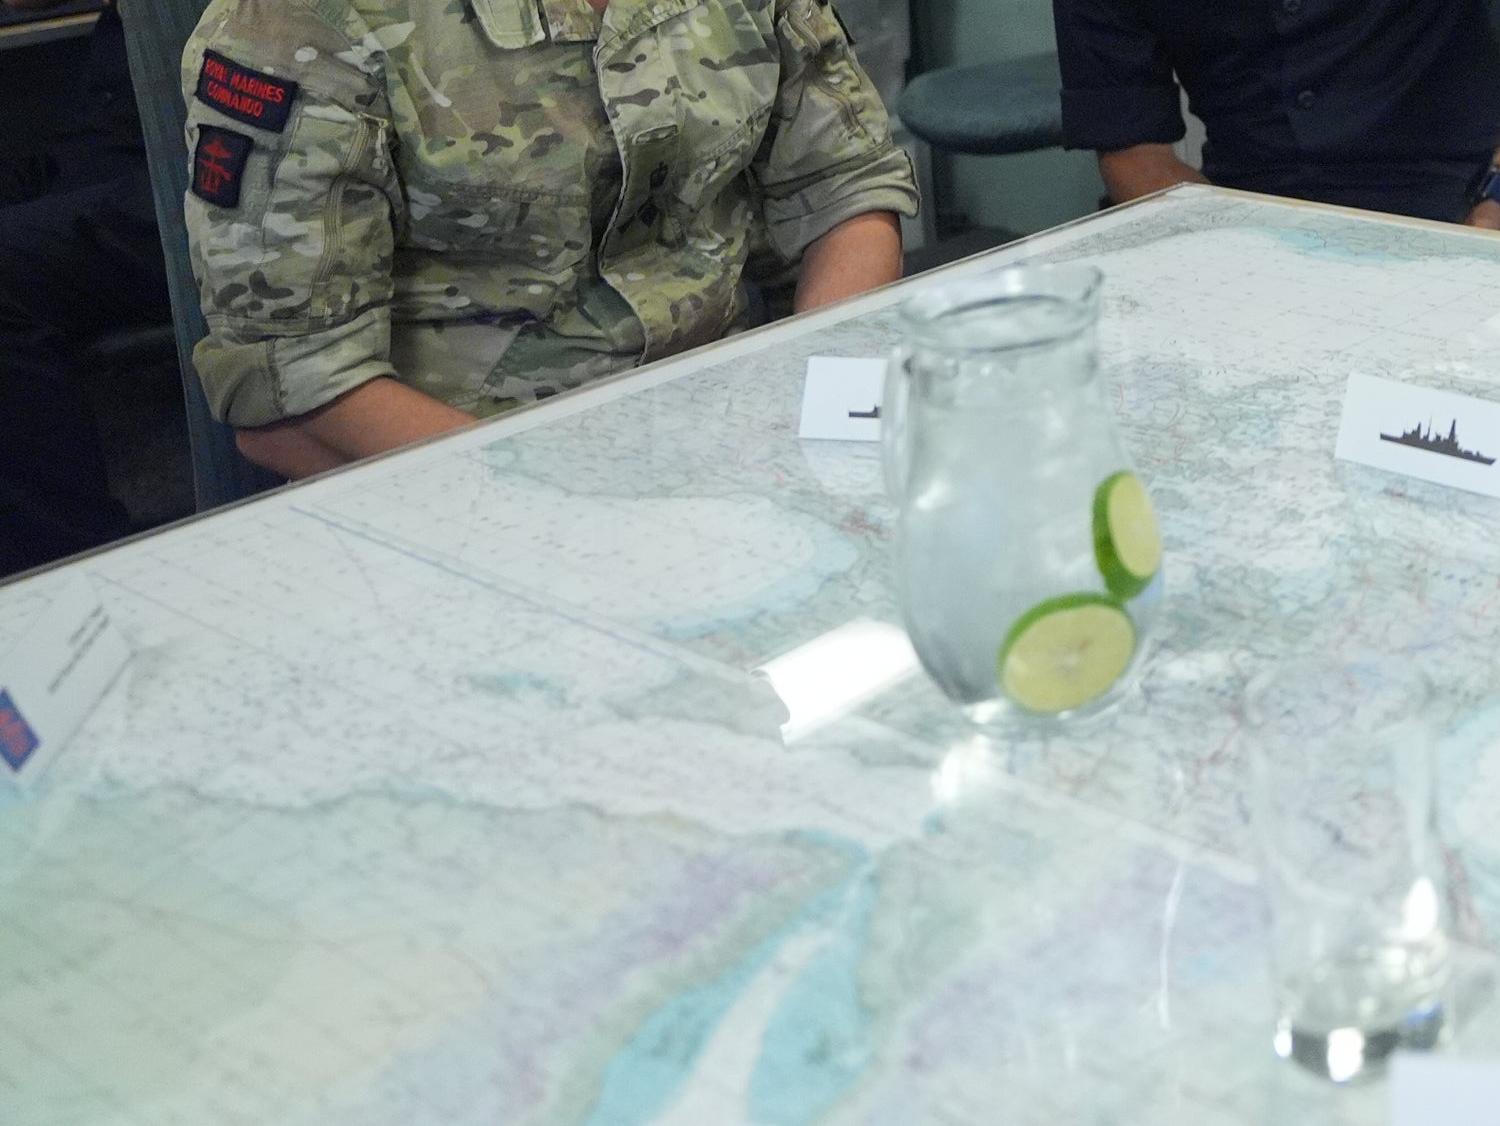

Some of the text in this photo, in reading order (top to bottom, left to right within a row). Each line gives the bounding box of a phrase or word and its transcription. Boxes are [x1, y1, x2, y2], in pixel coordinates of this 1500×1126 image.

[205, 58, 287, 104] ROYAL MARINES
[207, 81, 264, 118] COMMANDO
